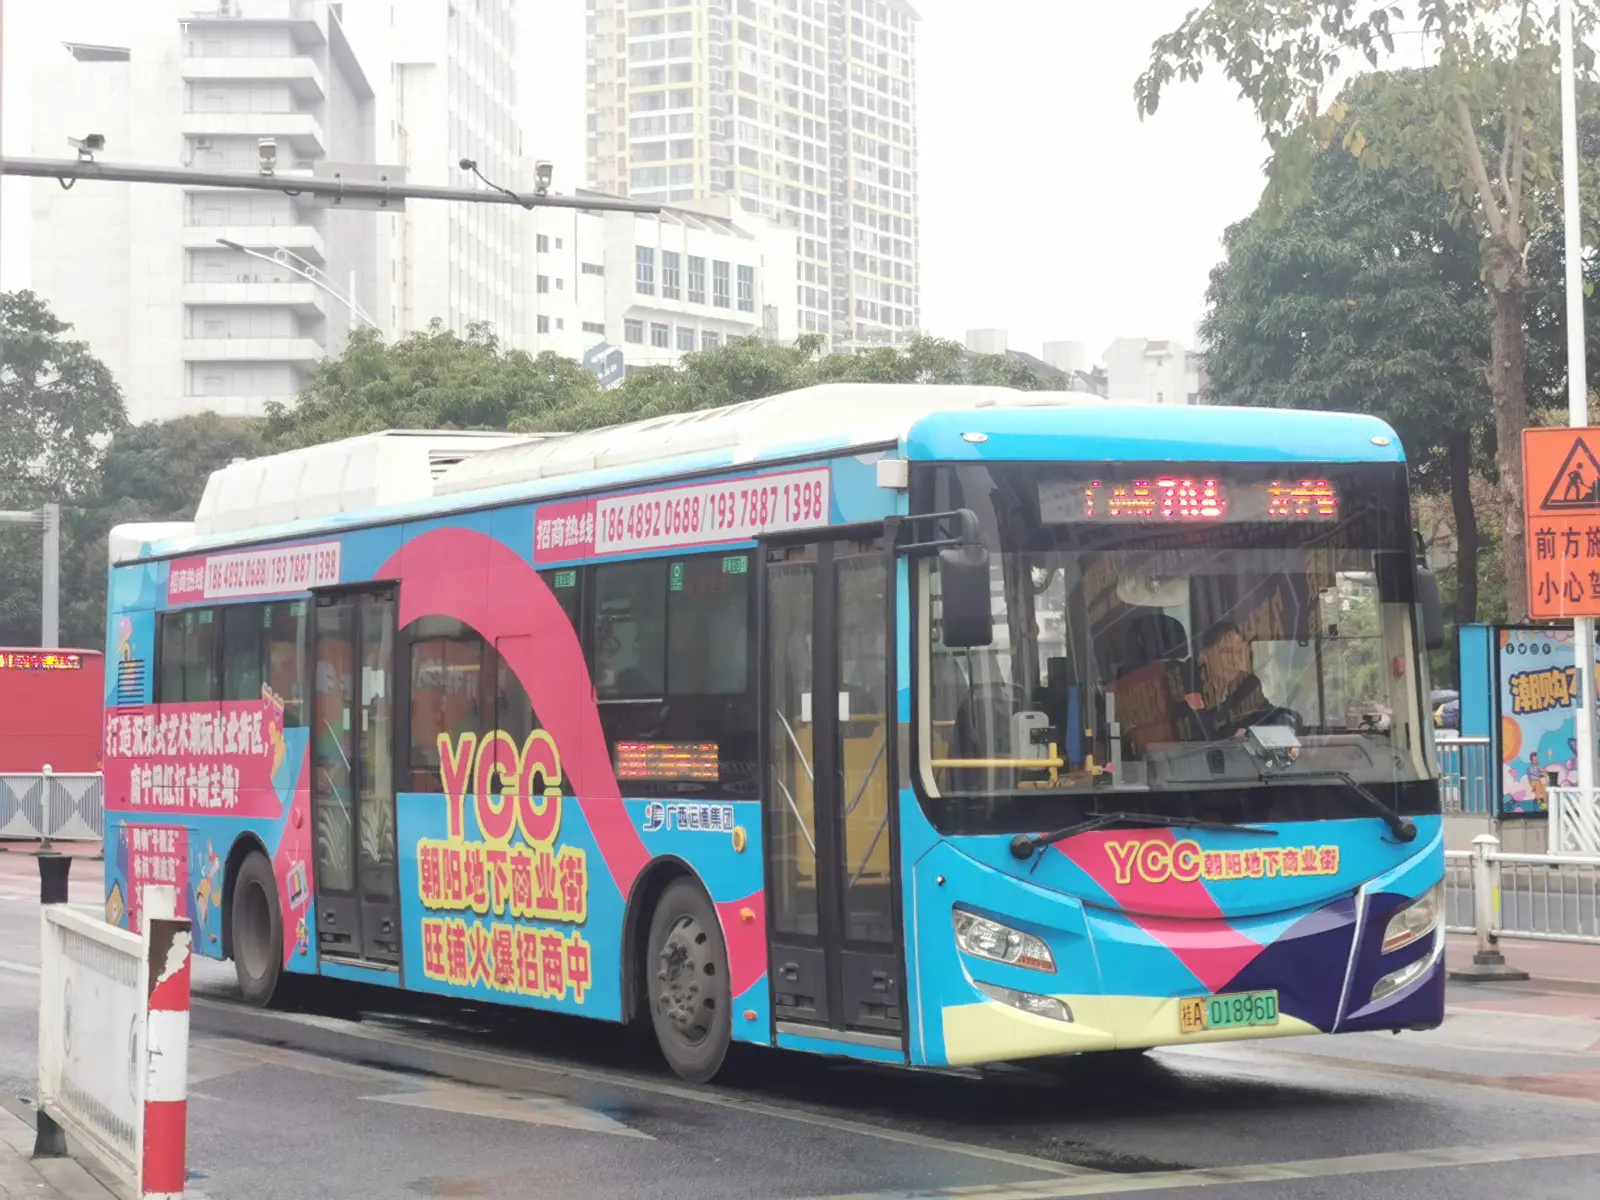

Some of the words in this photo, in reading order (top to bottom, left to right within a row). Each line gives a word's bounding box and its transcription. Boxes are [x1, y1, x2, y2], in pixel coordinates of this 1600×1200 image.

[536, 511, 595, 550] 招商热线
[601, 506, 624, 543] 186
[627, 501, 661, 540] 4892
[740, 486, 778, 528] 7887
[784, 480, 822, 523] 1398
[169, 566, 205, 594] 招商热线
[438, 729, 562, 843] YCC
[667, 804, 734, 832] 广西运德集团
[418, 842, 586, 919] 朝阳地下商业街
[1104, 839, 1201, 884] YCC
[1202, 845, 1339, 880] 朝阳地下商业街
[423, 919, 591, 1001] 旺铺火爆招商中
